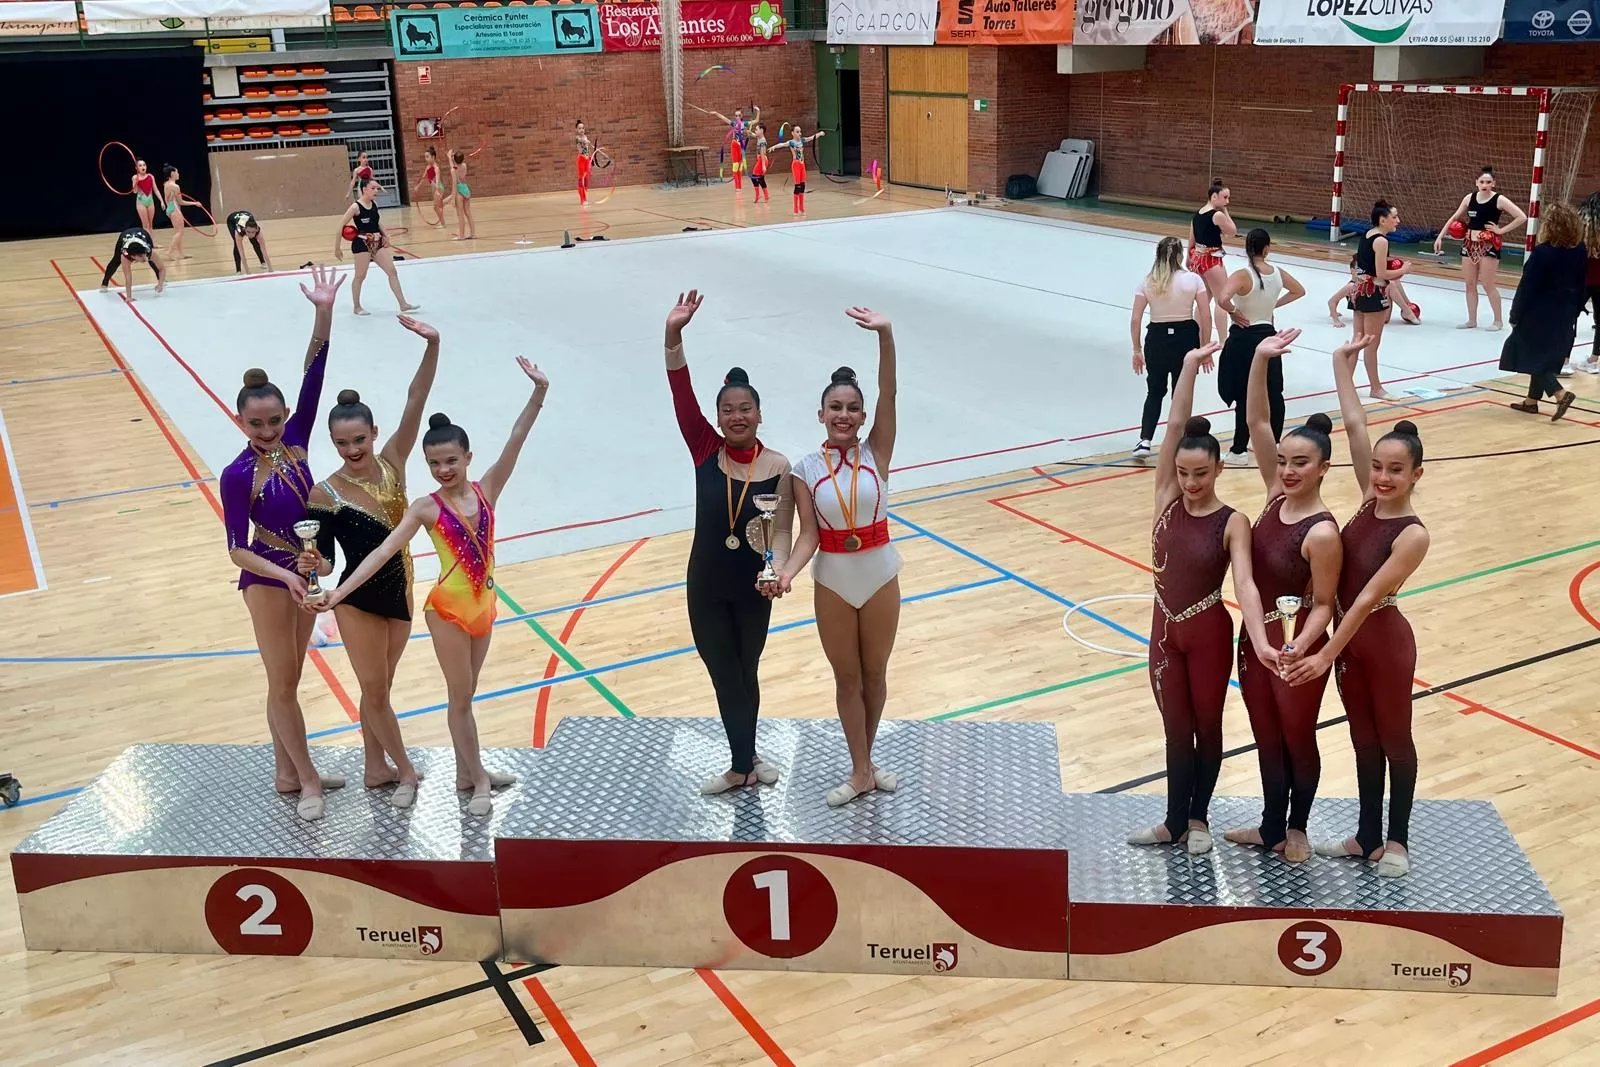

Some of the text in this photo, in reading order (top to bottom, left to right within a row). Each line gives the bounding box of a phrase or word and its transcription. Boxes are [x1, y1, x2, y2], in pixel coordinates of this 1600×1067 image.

[605, 4, 660, 17] Restaura
[984, 0, 1057, 13] Auto Talleres
[606, 16, 726, 38] Los Aantes
[982, 16, 1017, 30] Torres
[697, 36, 706, 44] 16
[711, 35, 725, 43] 978
[726, 35, 739, 43] 606
[740, 34, 754, 42] 006
[950, 30, 977, 38] SEAT
[235, 884, 283, 936] 2
[752, 869, 791, 941] 1
[356, 927, 417, 943] Teruel
[866, 943, 931, 960] Teruel
[1292, 931, 1328, 970] 3
[1391, 963, 1447, 977] Teruel
